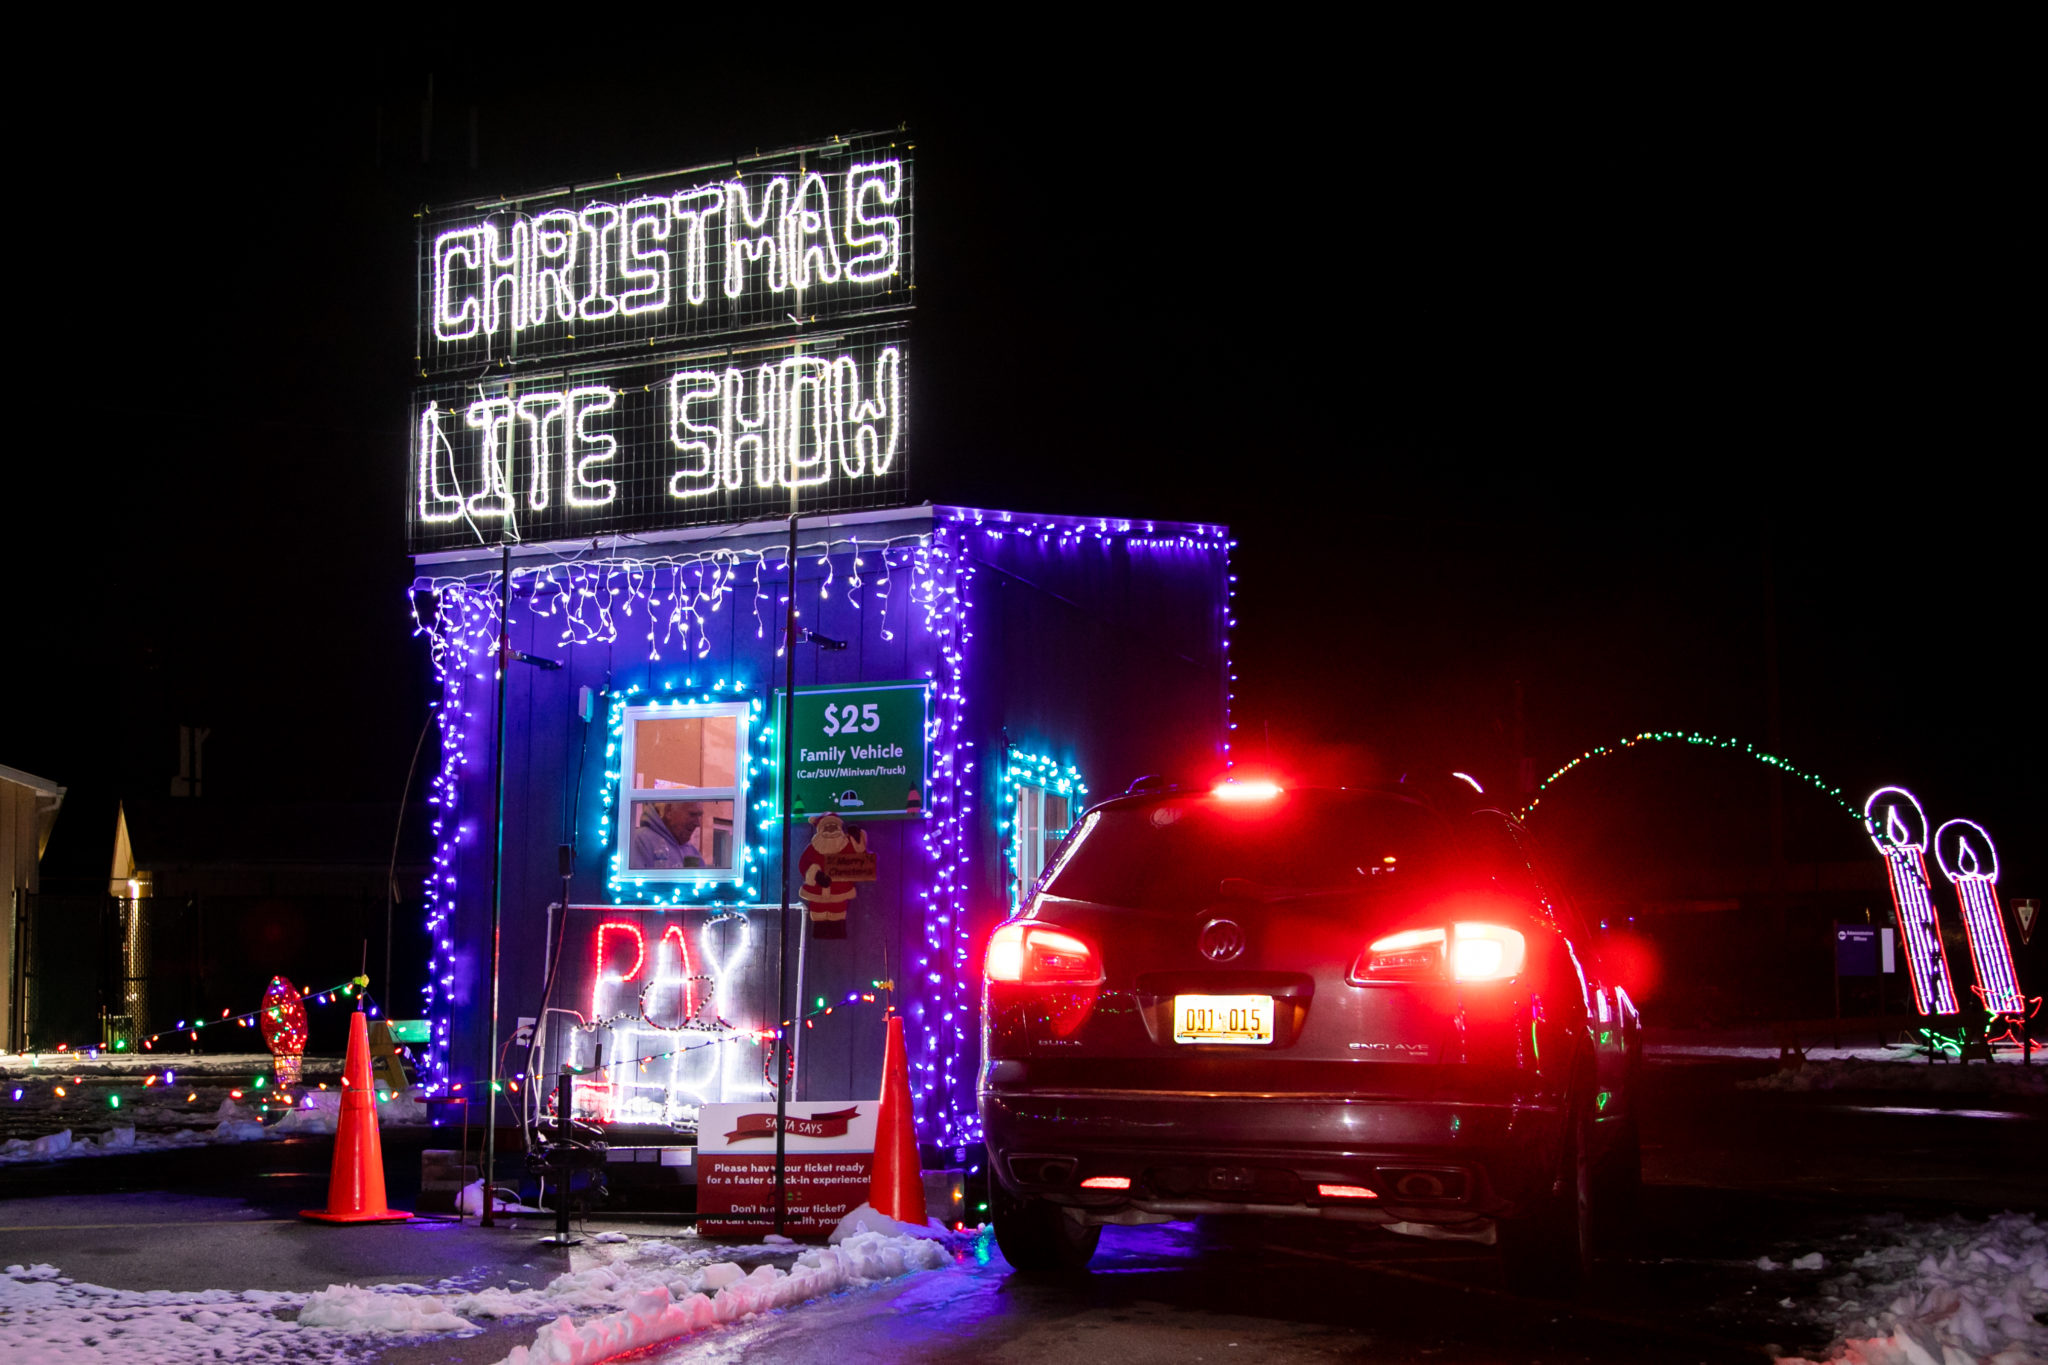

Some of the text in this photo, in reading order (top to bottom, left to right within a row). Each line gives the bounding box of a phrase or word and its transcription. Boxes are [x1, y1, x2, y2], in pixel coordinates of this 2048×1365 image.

[434, 159, 902, 342] CHRISTMAS
[419, 346, 900, 523] LITE SHOW
[823, 703, 881, 737] $25
[800, 743, 903, 765] Family Vehicle
[797, 765, 906, 779] (Car/SUV/Minivan/Truck)
[592, 914, 752, 1025] PAY
[1229, 1009, 1260, 1031] 015
[765, 1118, 823, 1134] SATA SAYS
[714, 1163, 748, 1172] Please
[804, 1163, 833, 1172] ticket
[835, 1162, 865, 1174] ready
[706, 1175, 721, 1185] for
[734, 1175, 764, 1185] faster
[766, 1175, 810, 1184] chck-in
[813, 1174, 871, 1187] experience!
[731, 1204, 756, 1213] Don't
[787, 1206, 810, 1215] your
[812, 1204, 847, 1213] ticket?
